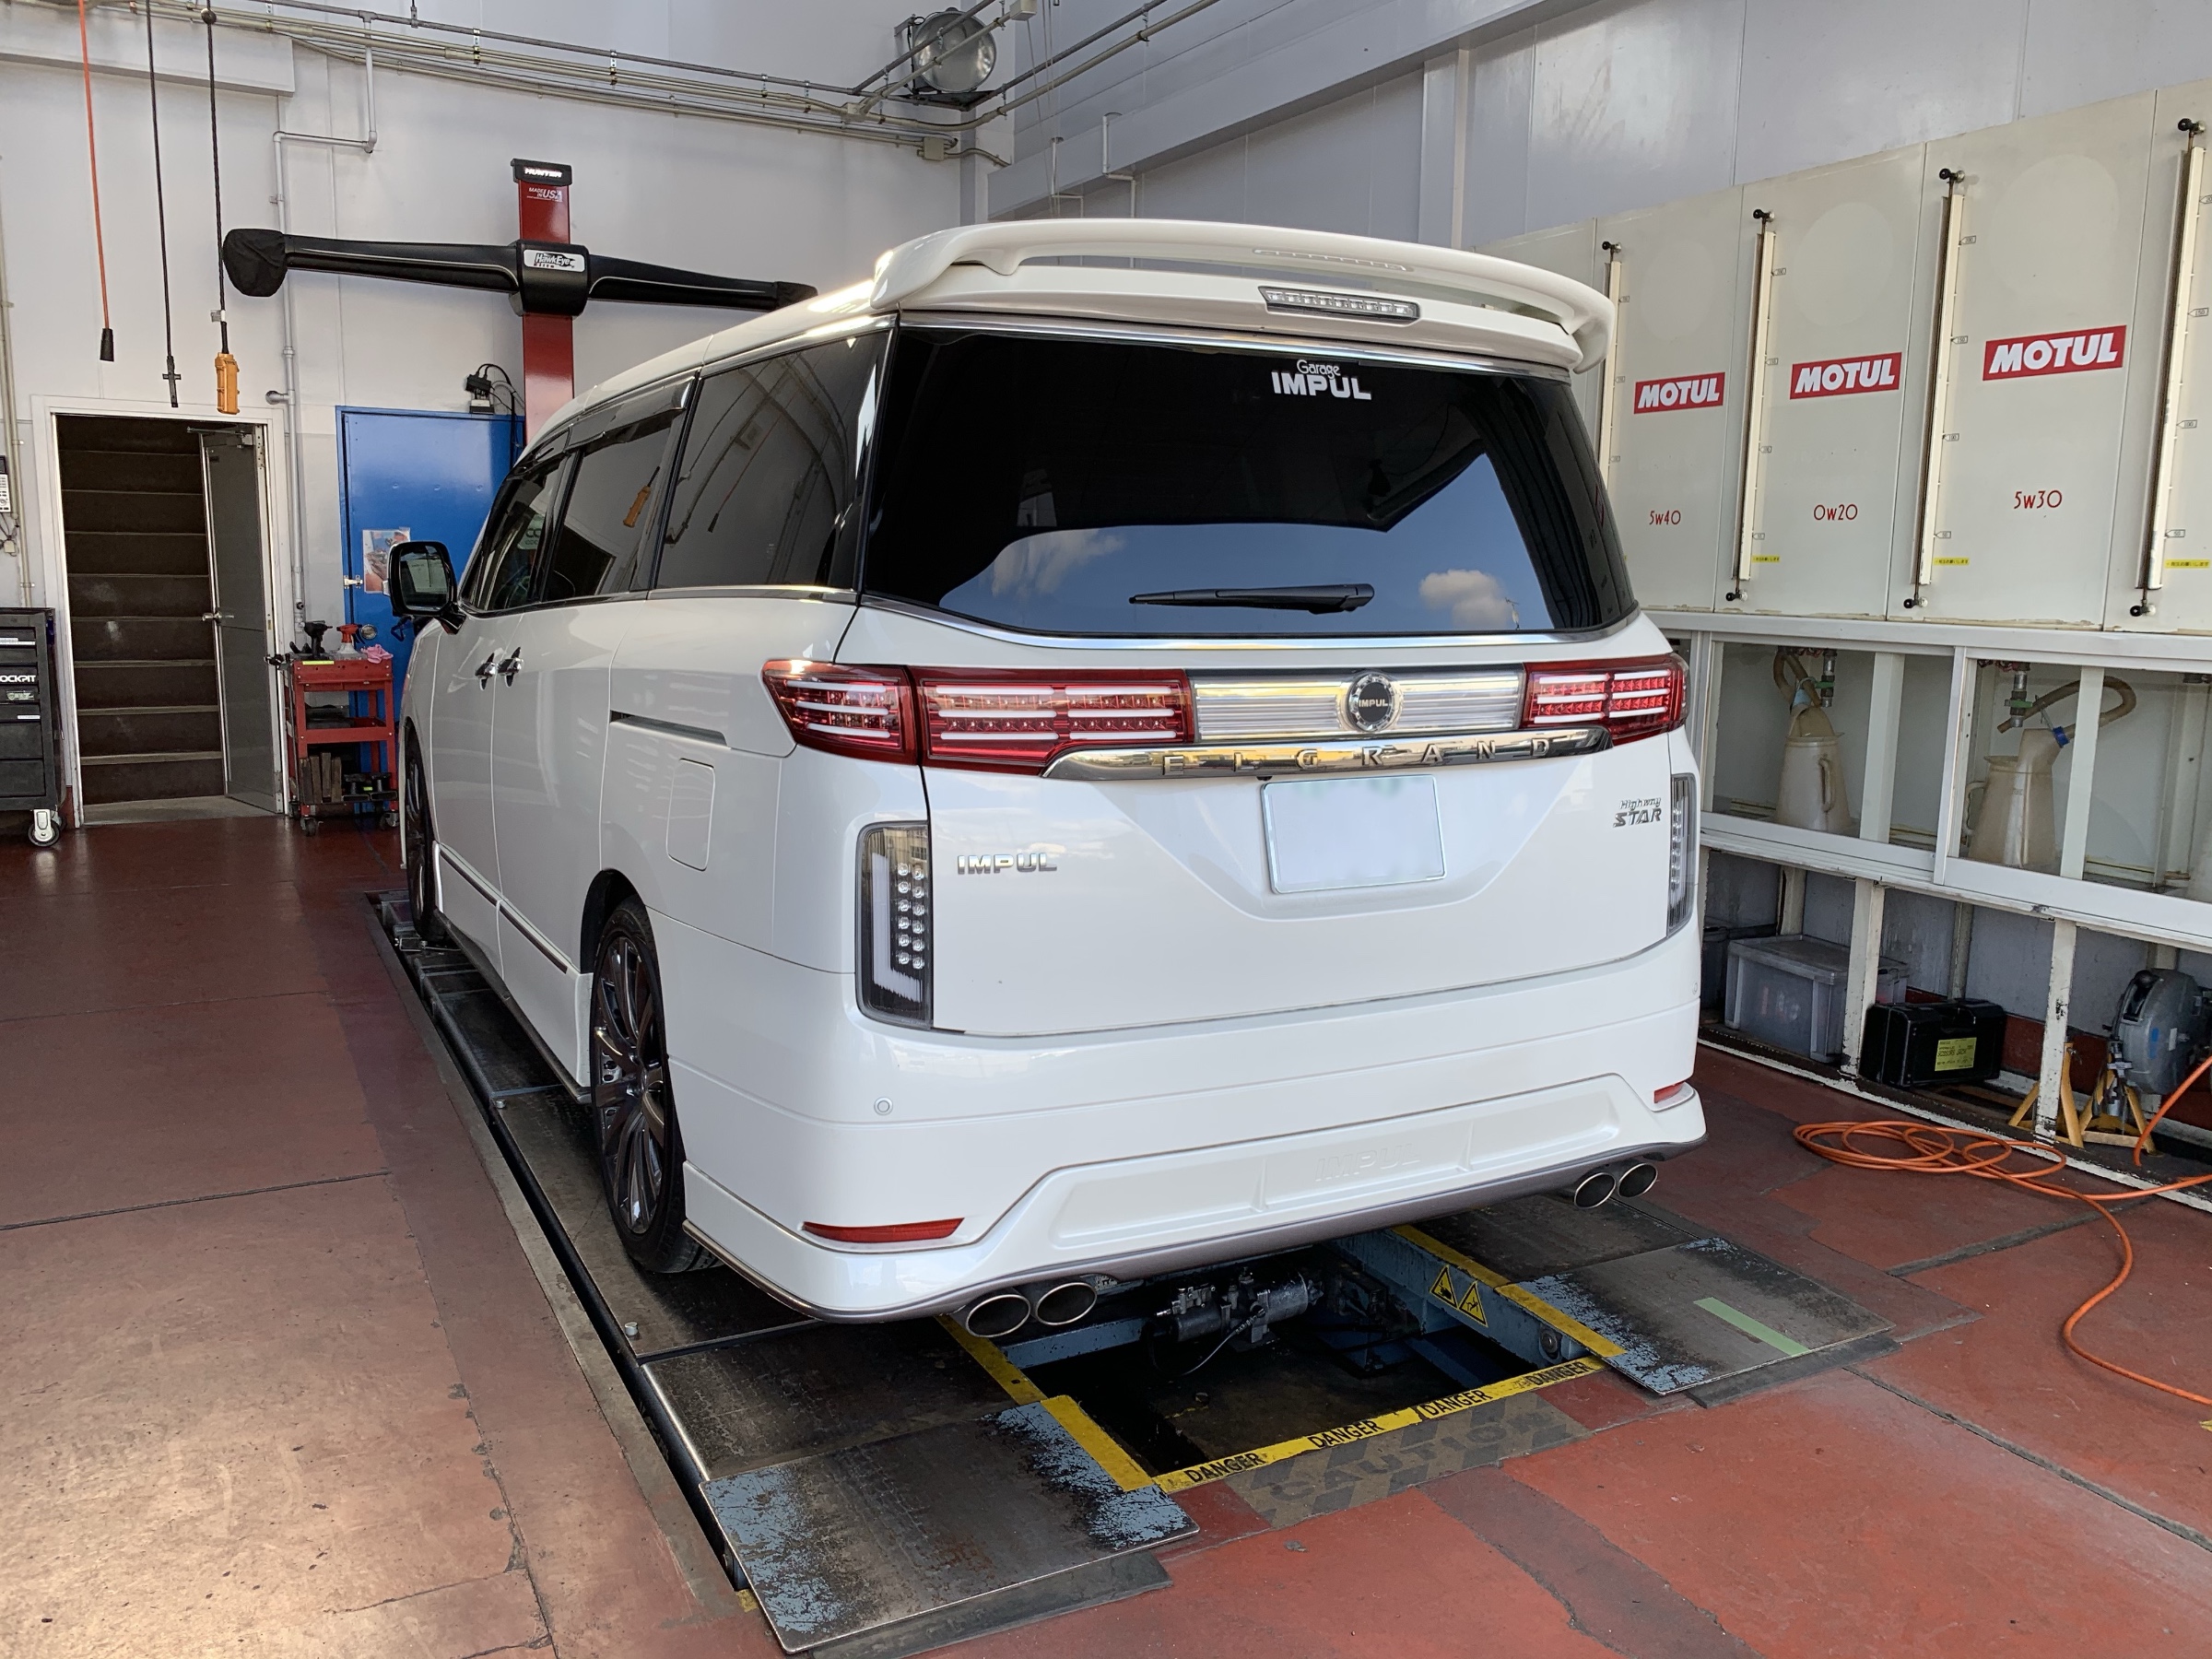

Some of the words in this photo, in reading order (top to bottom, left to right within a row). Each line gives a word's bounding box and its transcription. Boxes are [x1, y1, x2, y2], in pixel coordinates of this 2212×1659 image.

[543, 189, 563, 200] USA
[535, 253, 571, 266] HawkEye
[1989, 333, 2118, 374] MOTUL
[1296, 359, 1341, 380] Garage
[1794, 358, 1895, 394] MOTUL
[1271, 371, 1372, 400] IMPUL
[1638, 378, 1720, 408] MOTUL
[2014, 489, 2063, 509] 5w30
[1649, 510, 1681, 525] 5w40
[1359, 699, 1388, 707] IMPUL
[1162, 738, 1549, 775] ELGRAND
[1619, 797, 1661, 811] Highway
[1613, 807, 1662, 828] STAR
[958, 853, 1057, 875] IMPUL
[1315, 1144, 1420, 1182] IMPUL
[1525, 1361, 1593, 1386] DANGER
[1421, 1390, 1493, 1418] DANGER
[1307, 1419, 1384, 1448] DANGER
[1183, 1453, 1266, 1483] DANGER
